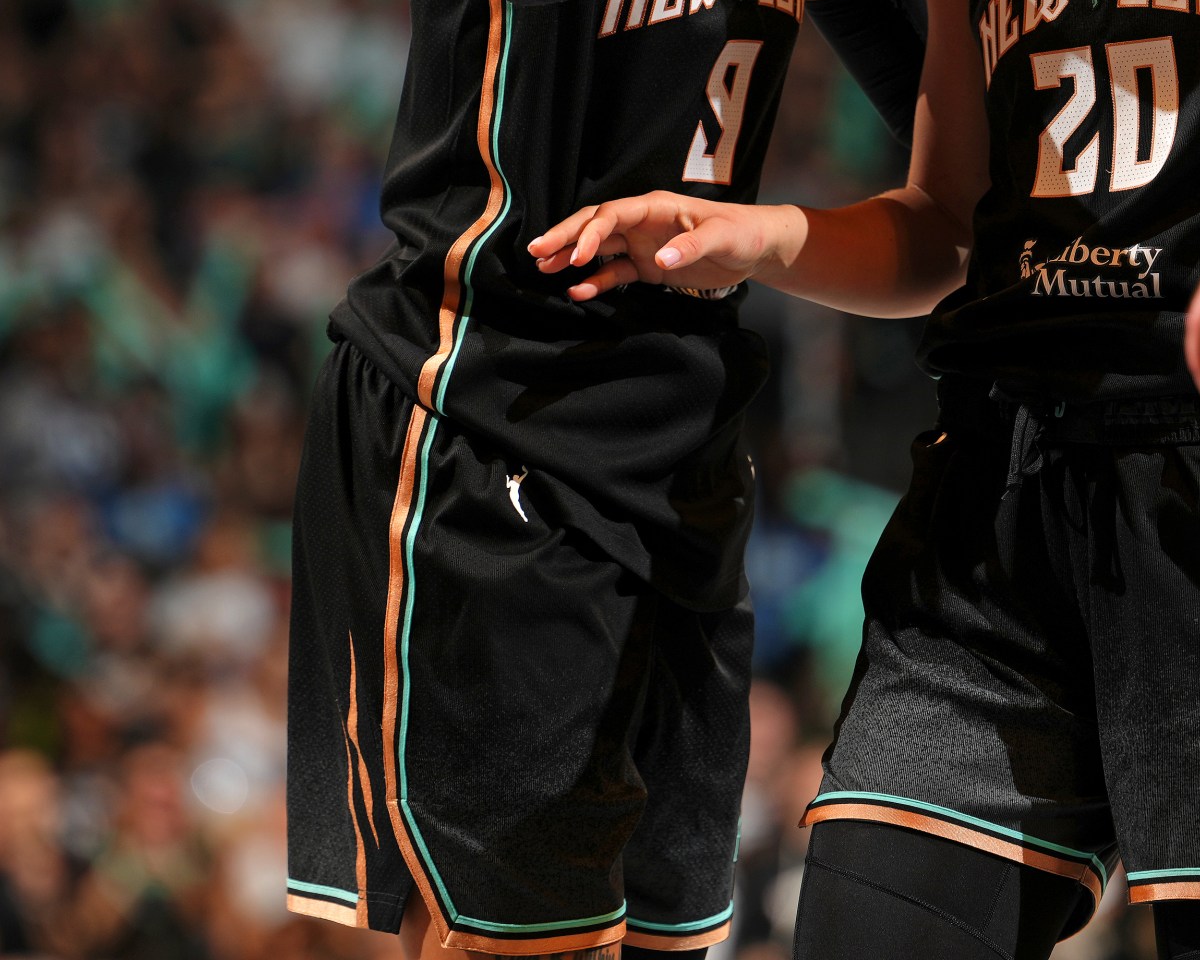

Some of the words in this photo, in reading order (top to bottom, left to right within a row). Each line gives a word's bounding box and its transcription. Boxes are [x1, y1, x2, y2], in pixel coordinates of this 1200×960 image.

[681, 39, 764, 186] 9
[1029, 36, 1180, 197] 20
[1031, 268, 1165, 299] Mutual
